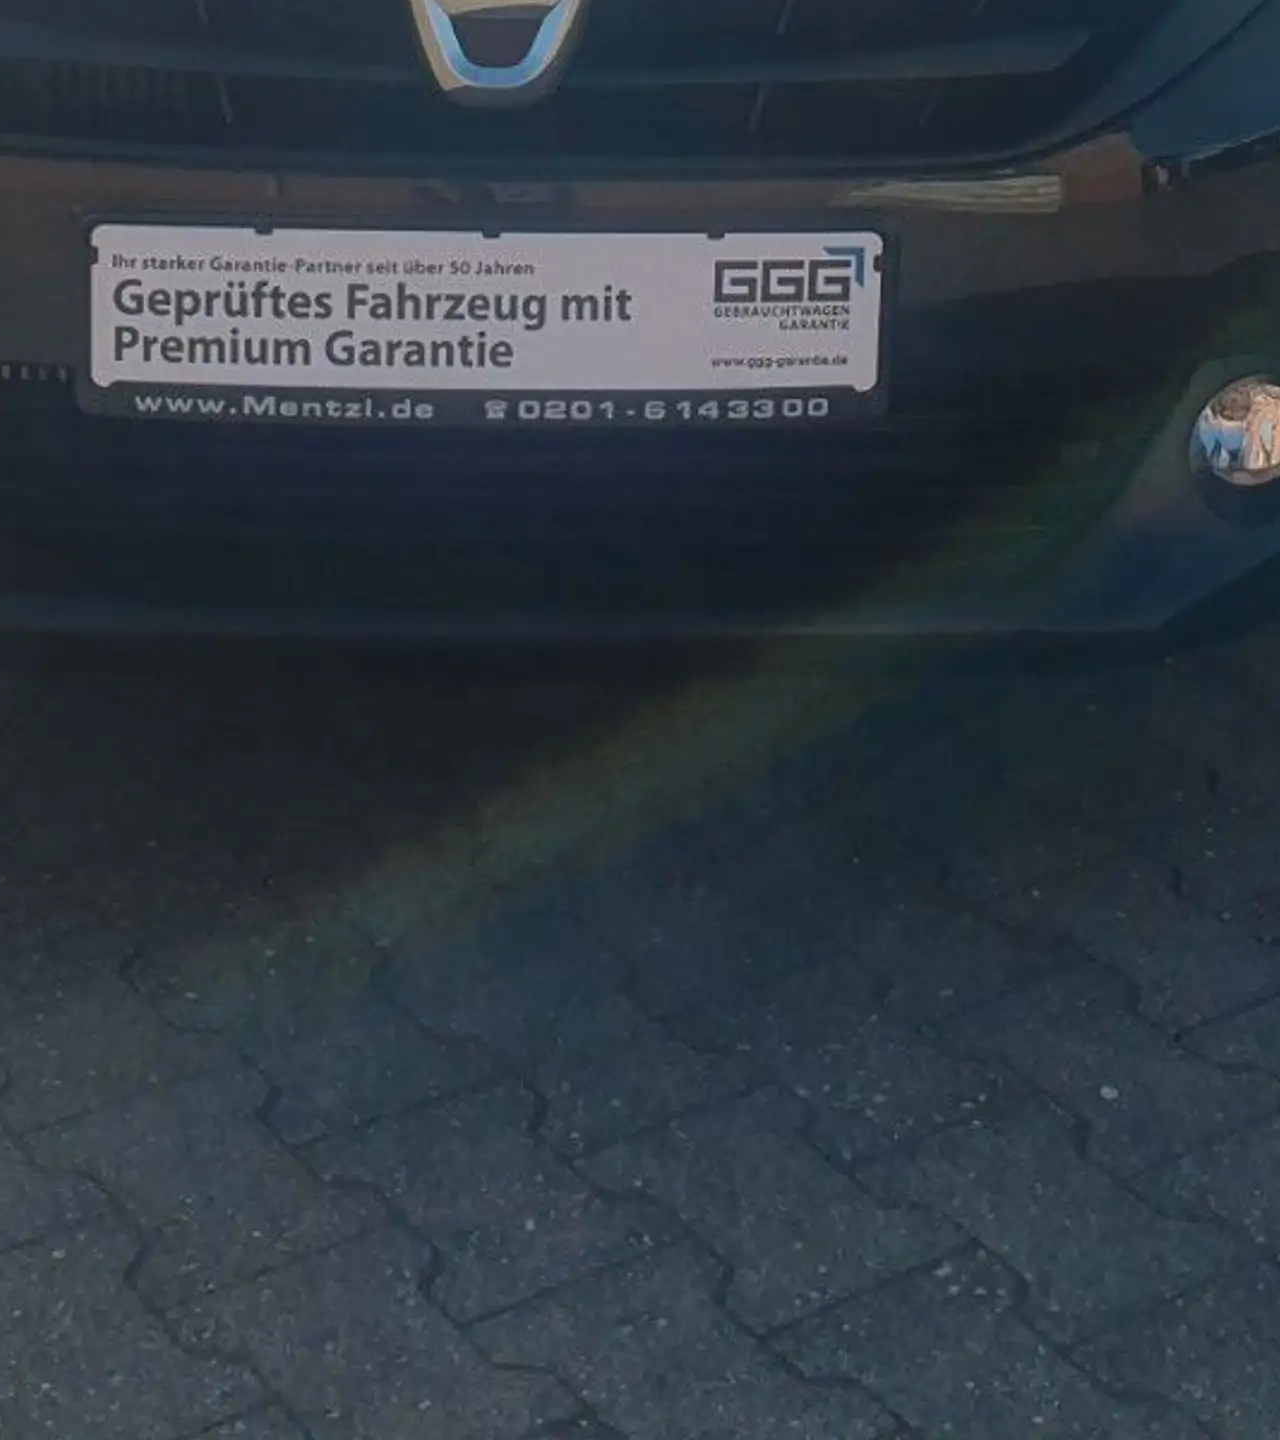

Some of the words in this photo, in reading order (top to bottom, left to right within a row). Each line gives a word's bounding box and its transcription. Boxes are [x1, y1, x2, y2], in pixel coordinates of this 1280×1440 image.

[111, 253, 136, 268] Ihr
[142, 254, 205, 271] starker
[209, 256, 362, 275] Garantie-Partner
[367, 260, 398, 275] seit
[403, 259, 445, 276] über
[450, 261, 471, 275] 50
[475, 260, 536, 276] Jahren
[713, 259, 853, 303] GGG
[113, 278, 333, 326] Geprüftes
[348, 281, 547, 331] Fahrzeug
[561, 284, 633, 322] mit
[713, 304, 851, 319] GEBRAUCHTWAGEN
[114, 326, 312, 366] Premium
[325, 329, 515, 368] Garantie
[134, 394, 435, 420] www.Mentzl.de
